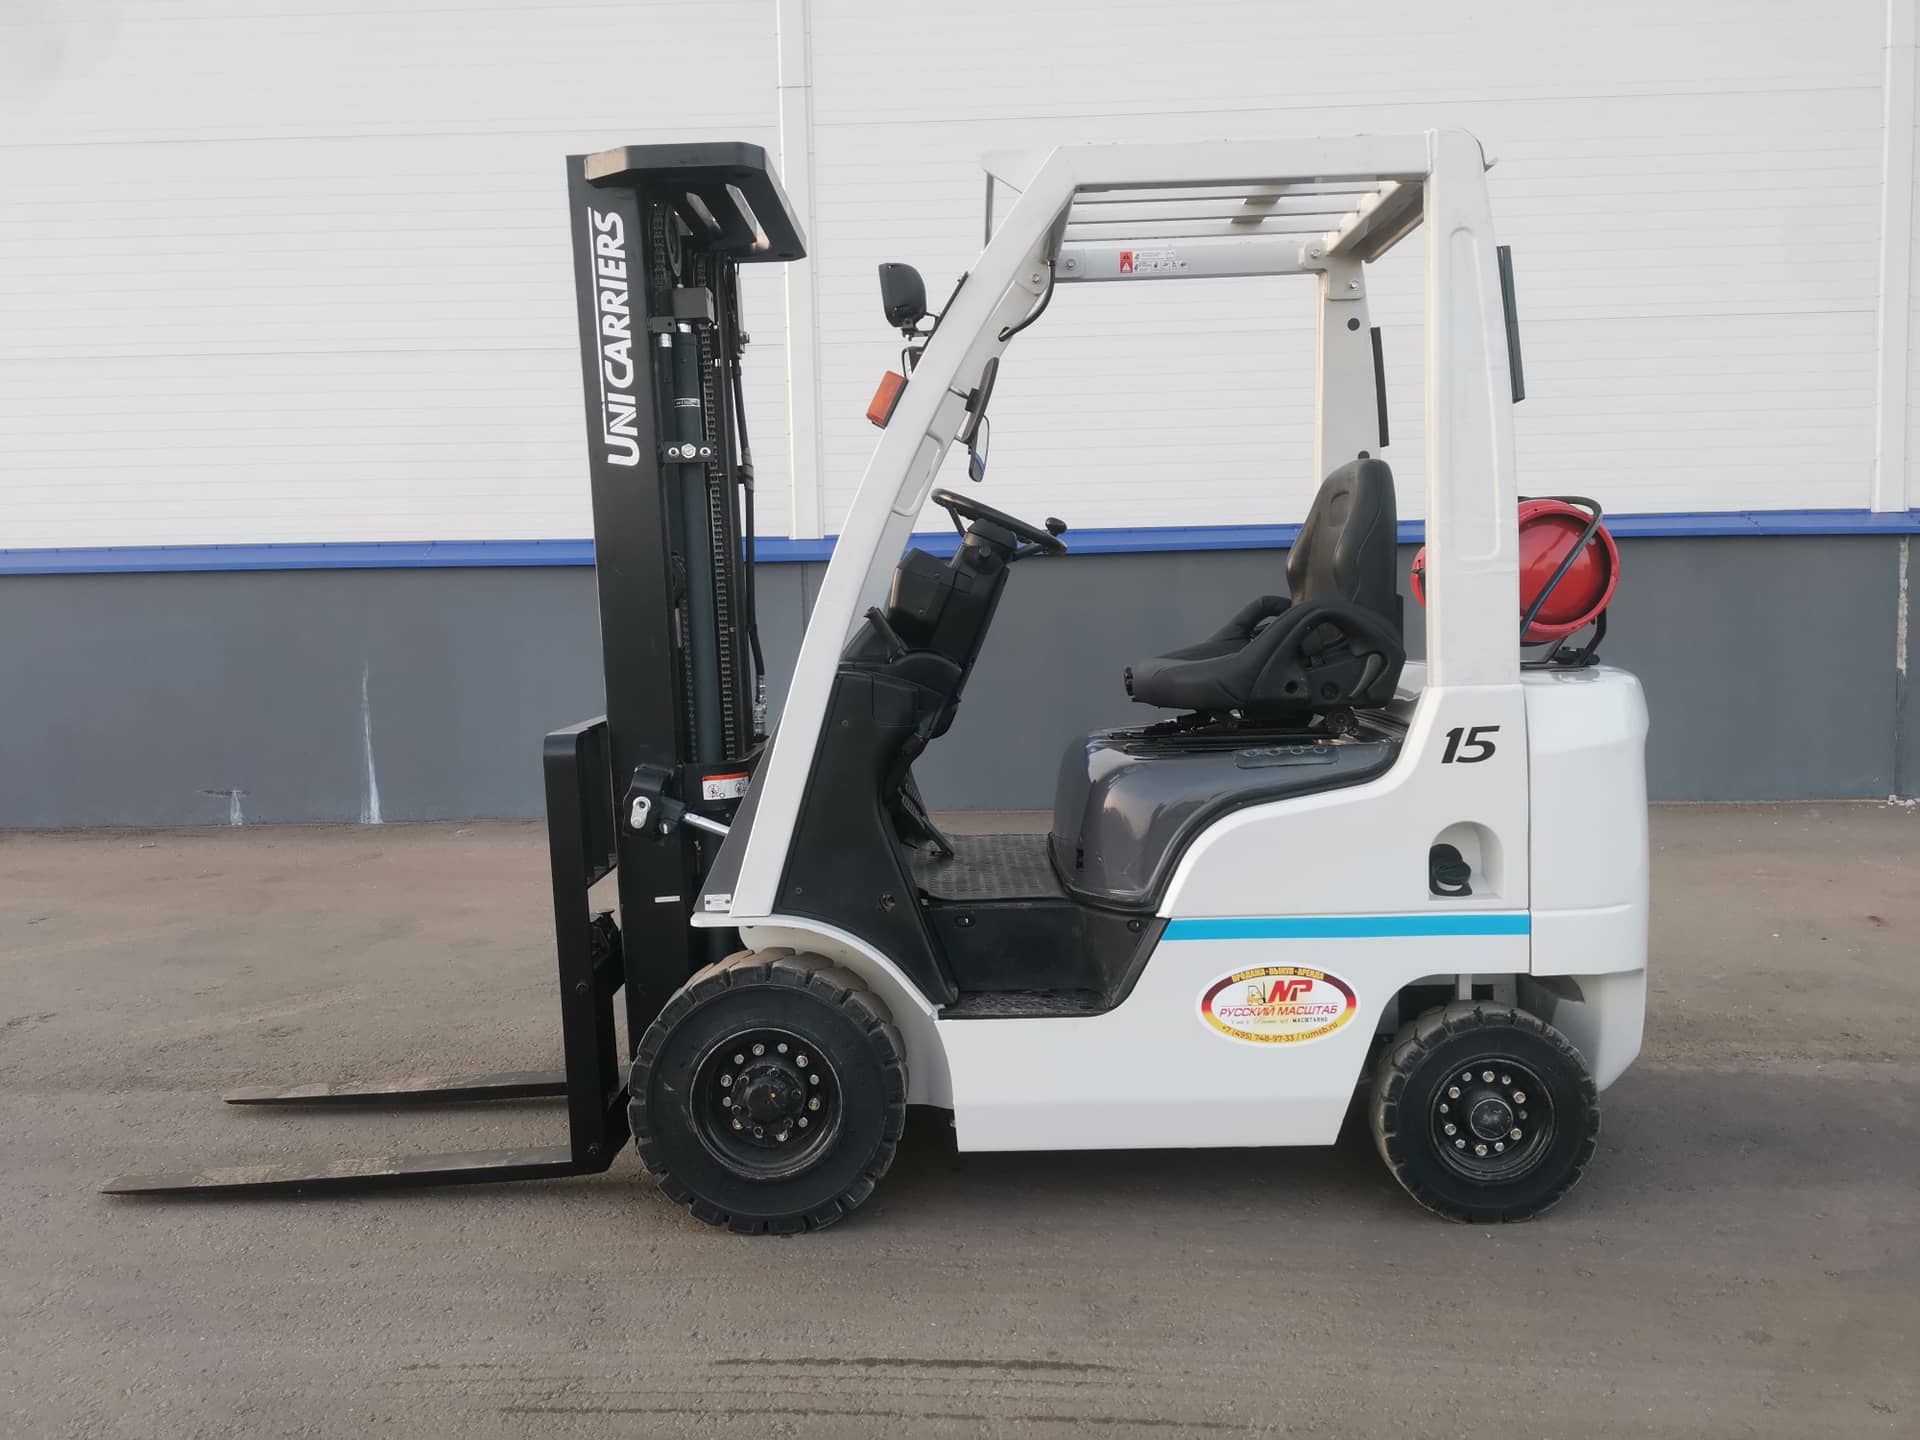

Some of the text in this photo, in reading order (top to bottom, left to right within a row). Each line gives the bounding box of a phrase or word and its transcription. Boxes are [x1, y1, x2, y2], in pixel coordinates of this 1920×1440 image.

[1441, 725, 1501, 764] 15
[1219, 1004, 1338, 1017] РУССКИЙ МАСШТАБ
